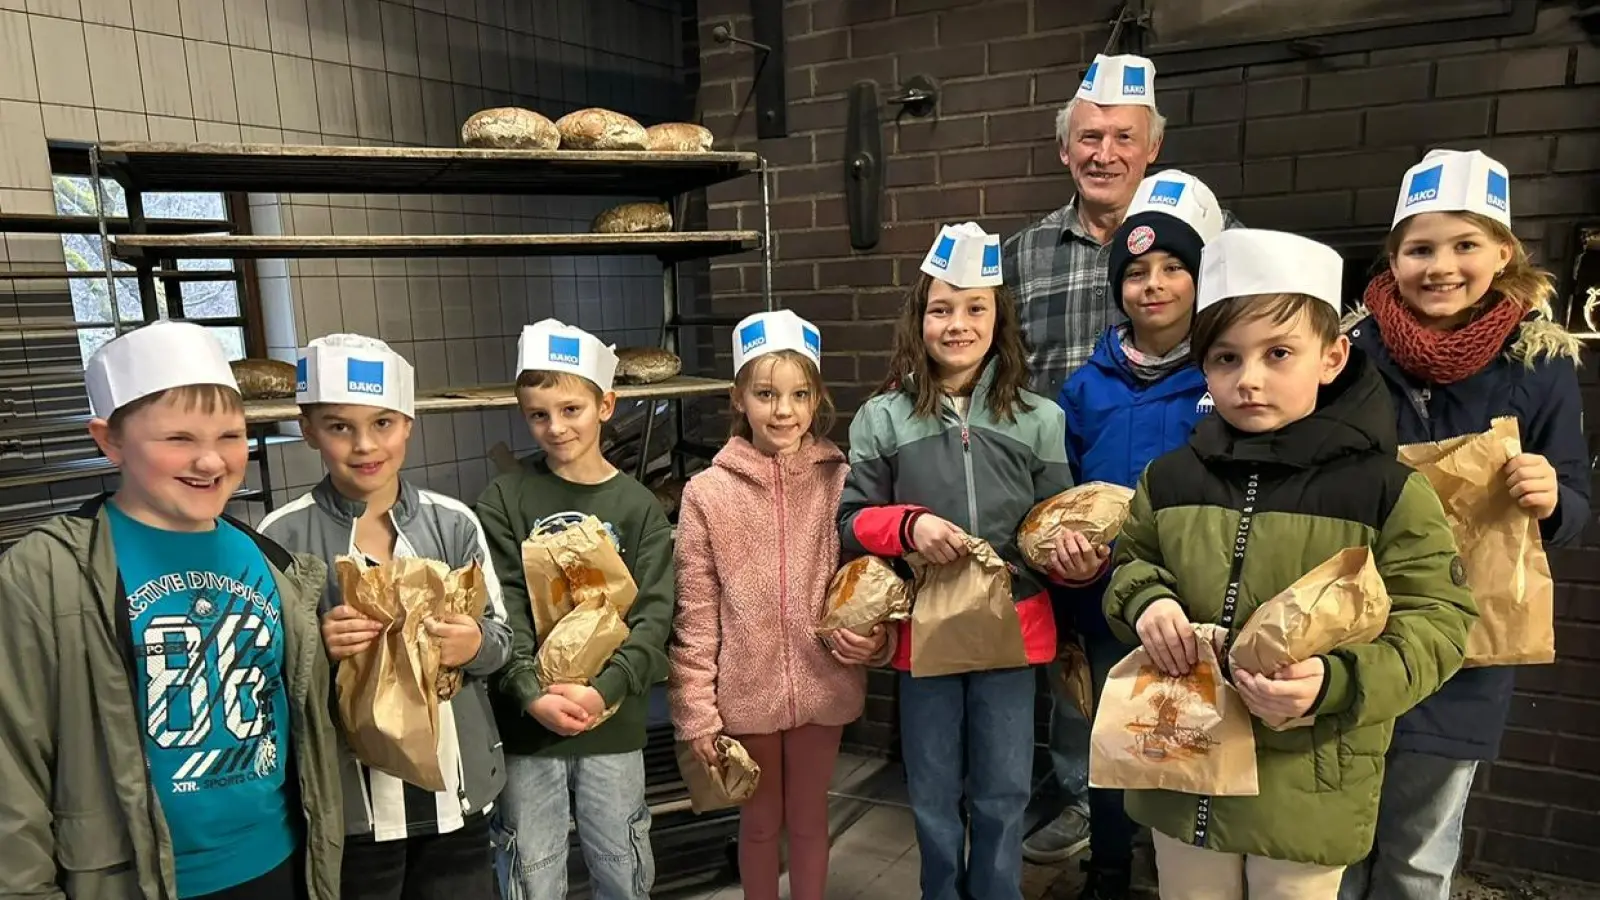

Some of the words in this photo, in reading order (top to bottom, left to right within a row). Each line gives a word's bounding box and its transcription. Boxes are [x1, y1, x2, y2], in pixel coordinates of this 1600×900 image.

[1235, 516, 1251, 558] SCOTCH
[1246, 473, 1260, 502] SODA
[186, 571, 279, 624] DIVISION
[1225, 582, 1239, 611] SODA
[144, 614, 271, 748] 86
